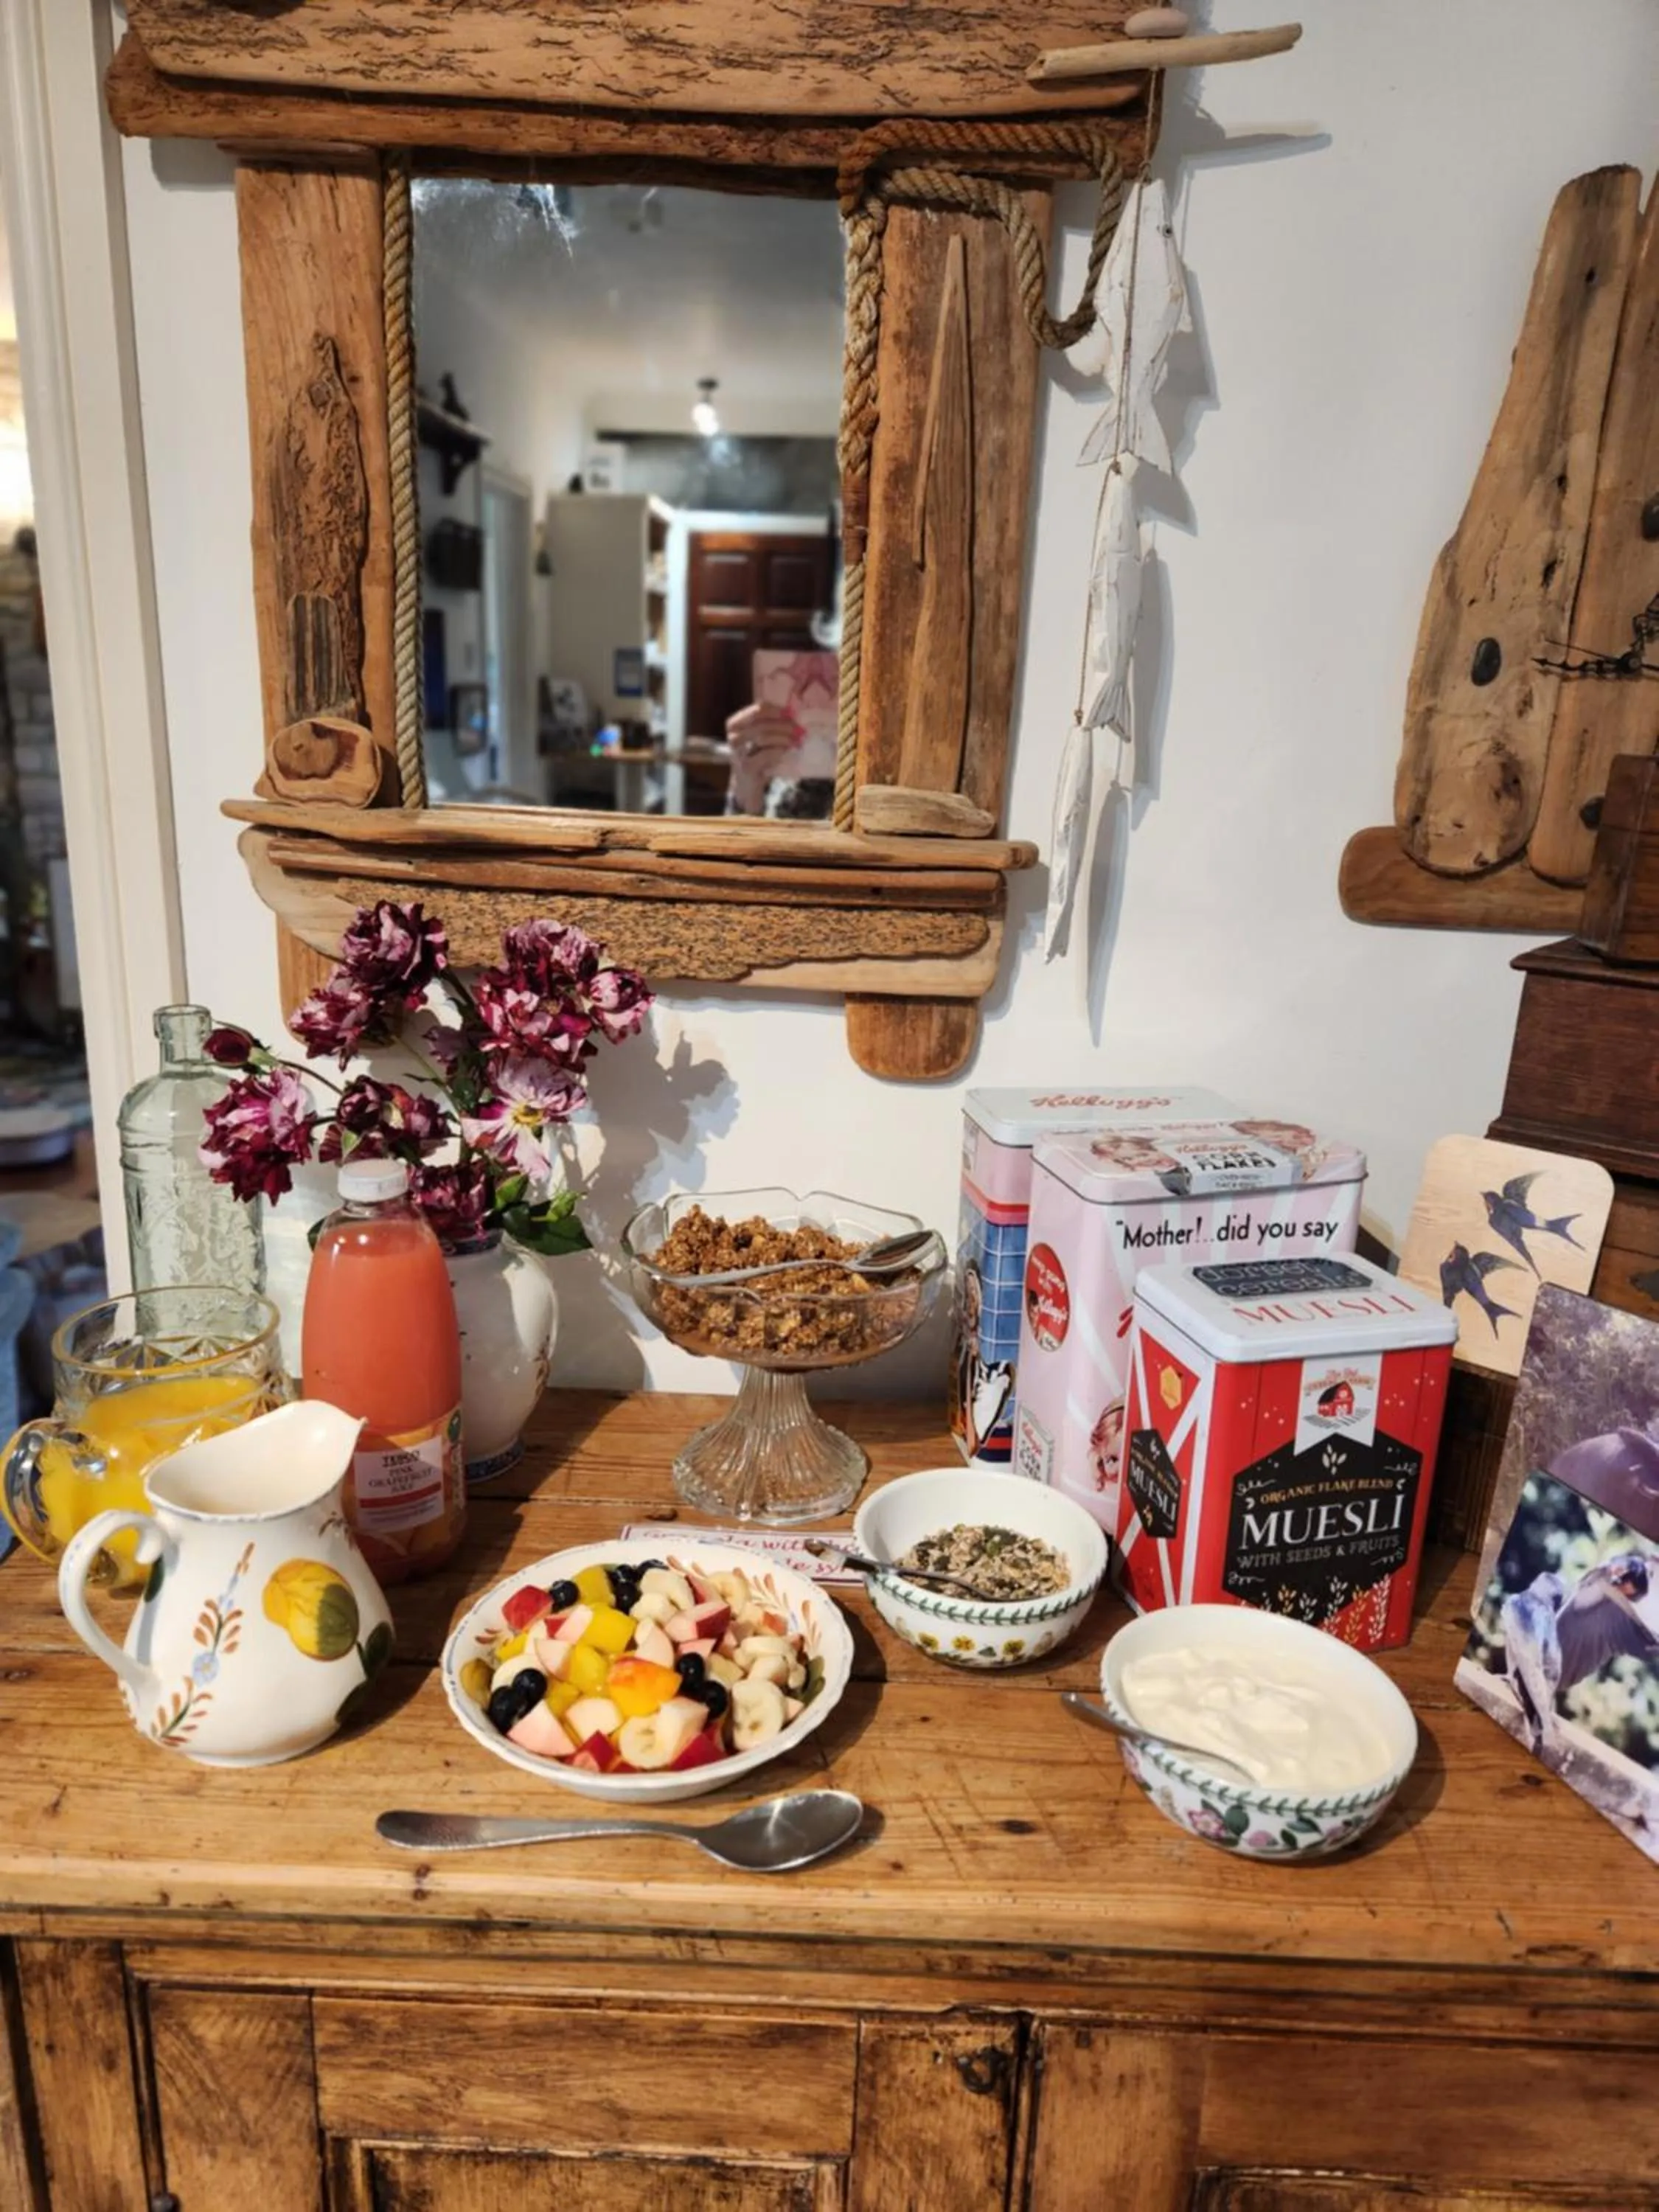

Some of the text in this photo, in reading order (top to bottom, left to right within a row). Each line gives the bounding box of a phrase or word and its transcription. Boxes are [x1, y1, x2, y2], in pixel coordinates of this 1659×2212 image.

[1029, 1094, 1172, 1110] Kellogg's
[1256, 1221, 1297, 1246] you
[1301, 1220, 1340, 1243] say
[1197, 1260, 1321, 1282] dorset
[1217, 1270, 1363, 1295] cereals
[1232, 1295, 1417, 1326] MUESLI
[1130, 1457, 1178, 1522] MUESLI
[1260, 1478, 1394, 1506] ORGANIC FLAKE BLEND
[1238, 1494, 1406, 1551] MUESLI
[1237, 1534, 1401, 1570] WITH SEEDS & FRUITS
